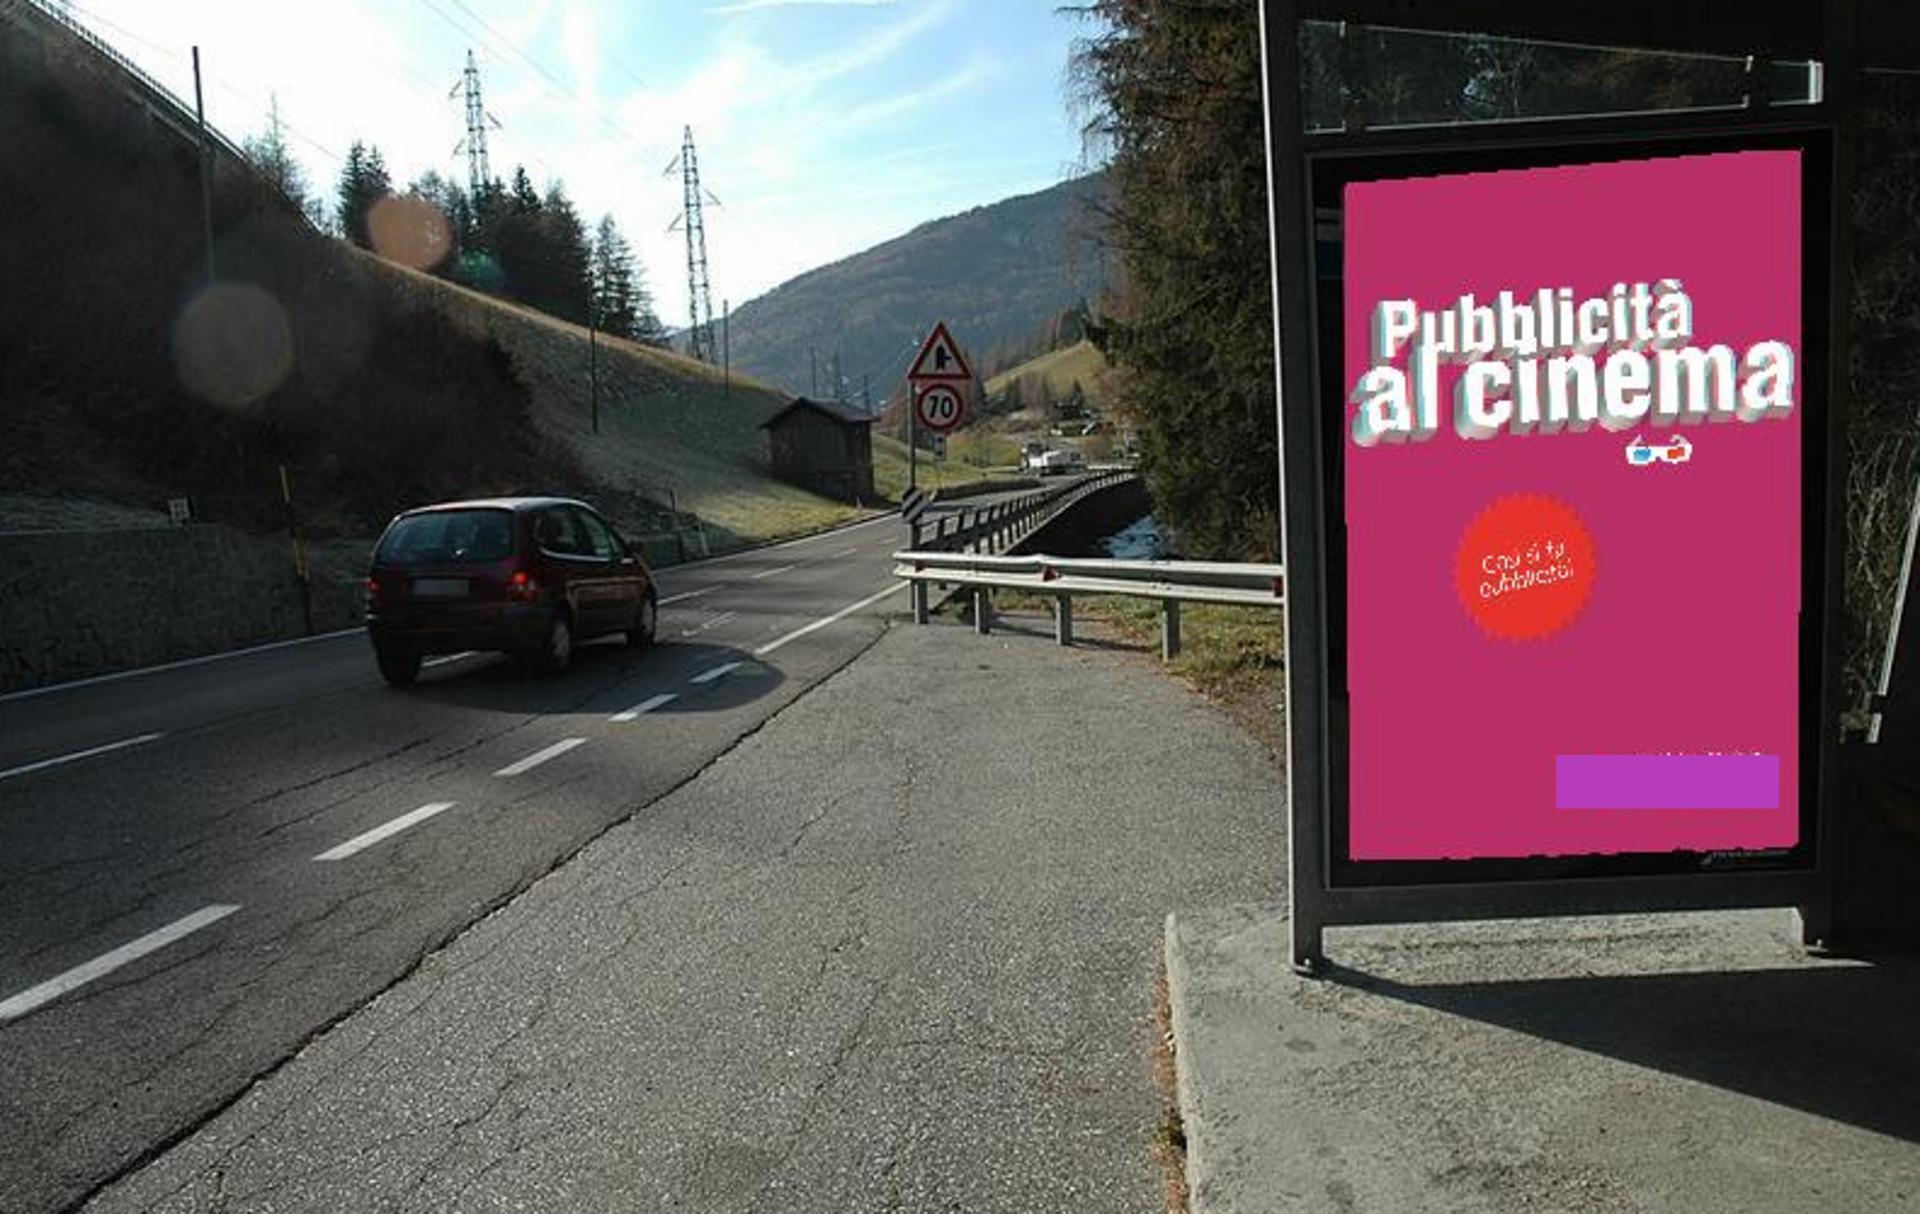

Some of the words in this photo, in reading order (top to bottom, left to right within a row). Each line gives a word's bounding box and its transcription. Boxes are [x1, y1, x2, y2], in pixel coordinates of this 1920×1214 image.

[1372, 279, 1692, 366] Pubblicità
[929, 395, 954, 418] 70
[1352, 341, 1438, 446] al
[1454, 340, 1795, 440] cinema
